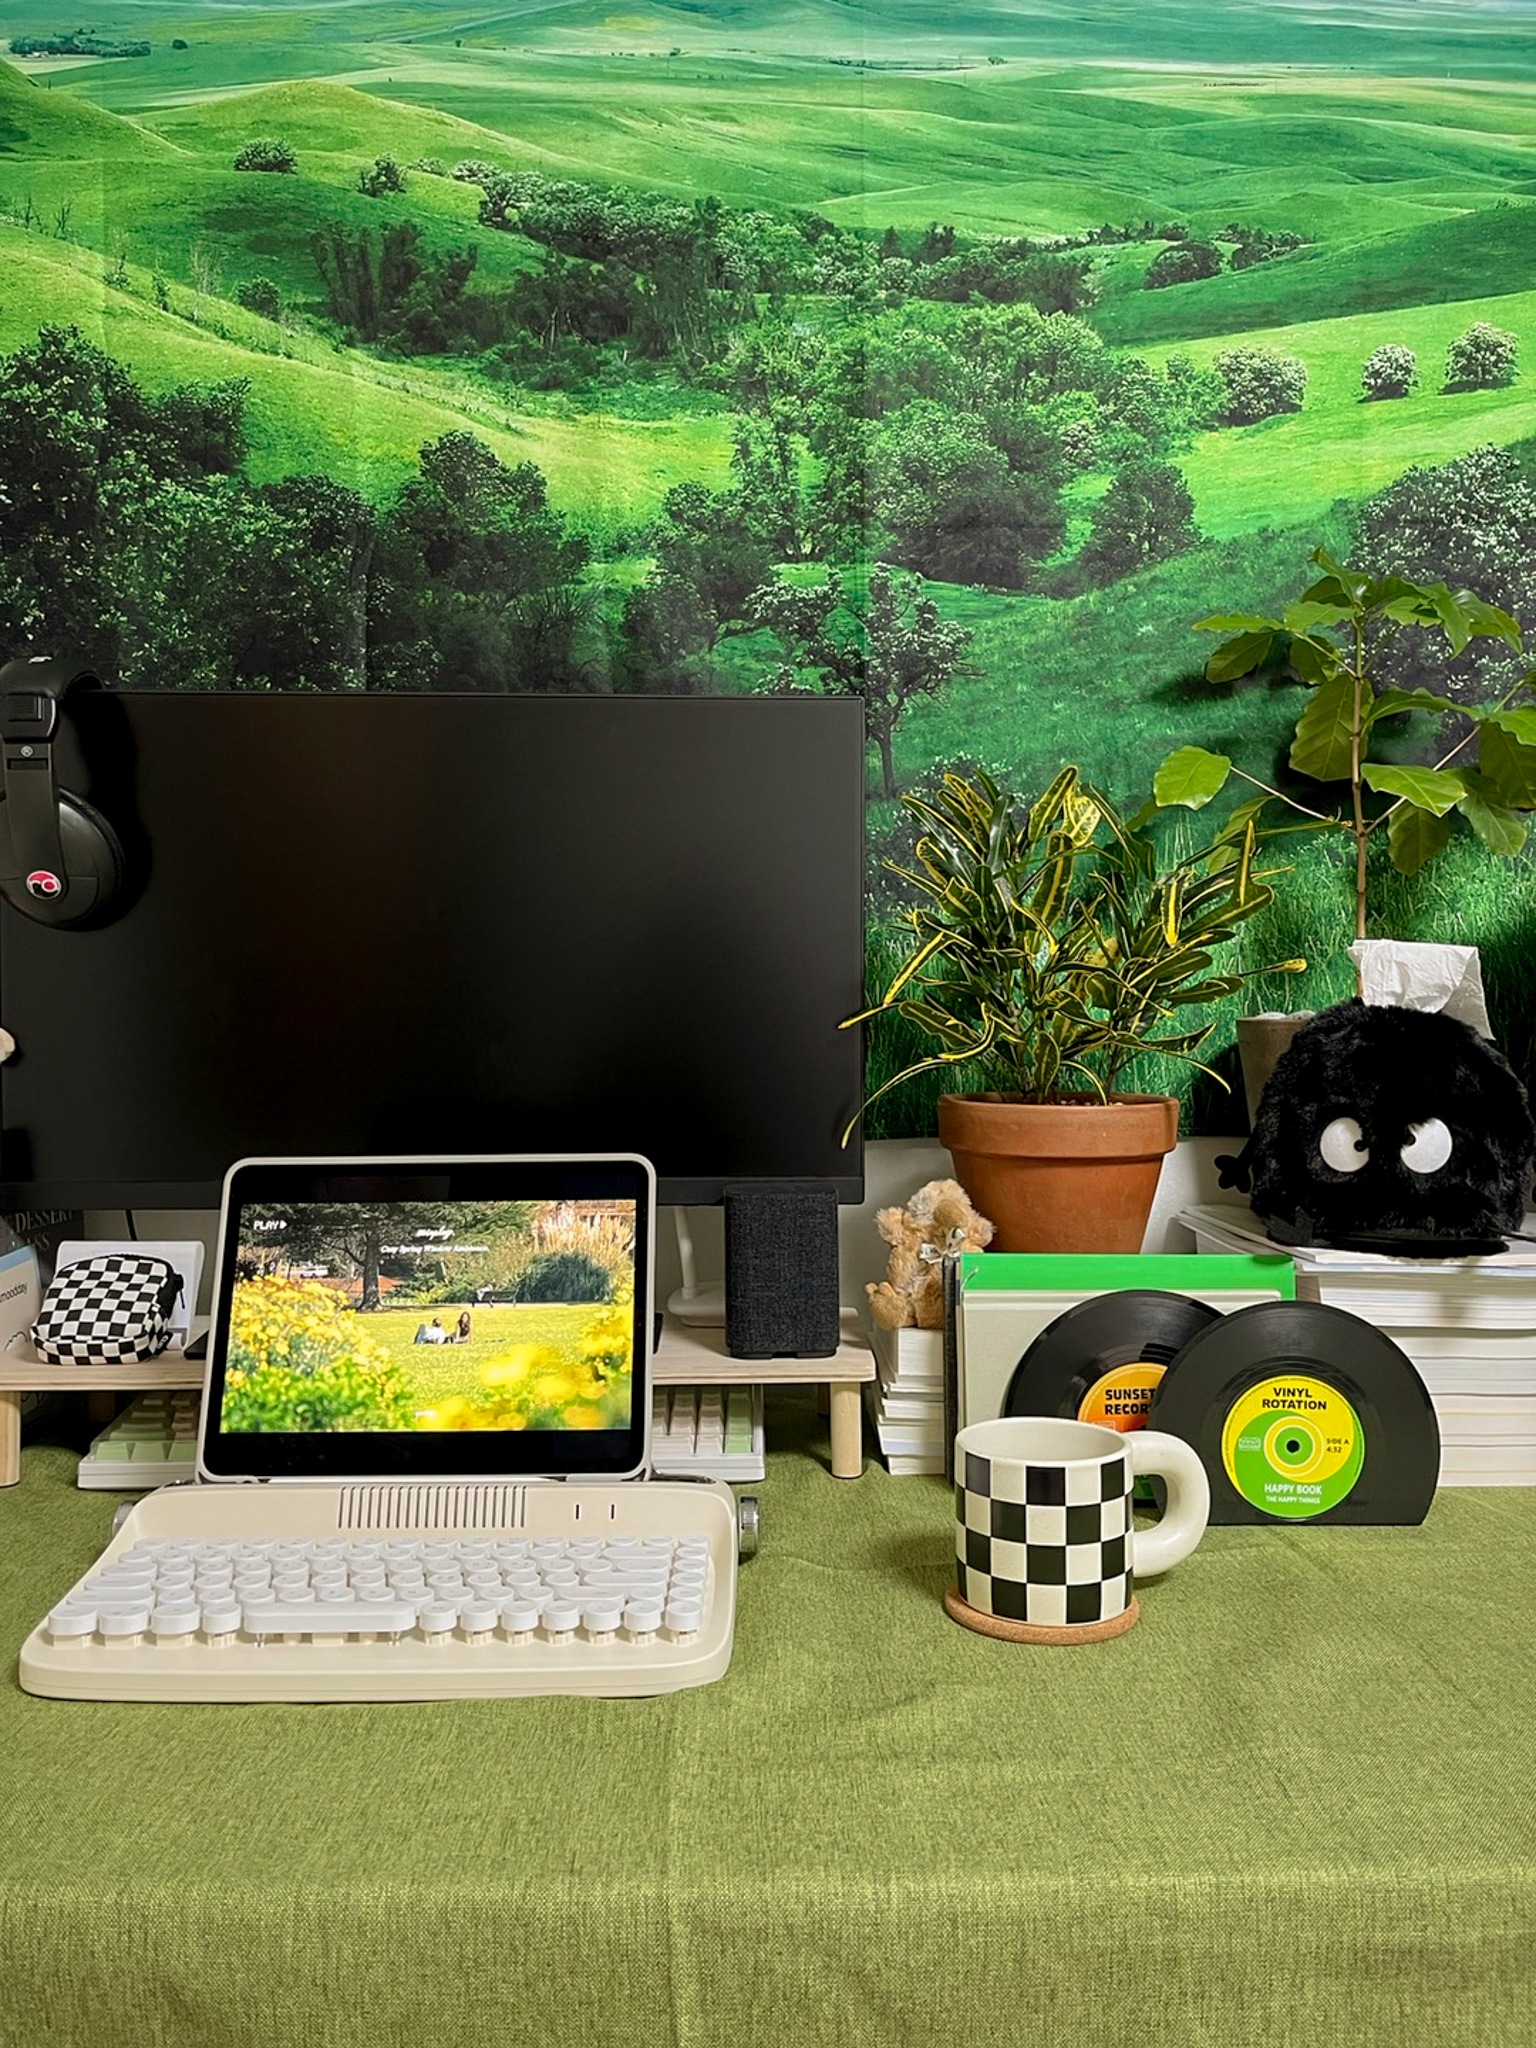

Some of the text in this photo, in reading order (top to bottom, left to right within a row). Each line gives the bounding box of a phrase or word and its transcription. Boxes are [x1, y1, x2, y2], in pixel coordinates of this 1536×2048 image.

[253, 1219, 279, 1230] PLAY
[1105, 1388, 1155, 1401] SUNSET
[1273, 1387, 1312, 1398] VINYL
[1105, 1403, 1151, 1415] RECOR
[1262, 1399, 1327, 1410] ROTATION
[1264, 1483, 1322, 1495] HAPPY BOOK
[1278, 1496, 1297, 1504] HAPPY
[1298, 1496, 1320, 1505] THINGS
